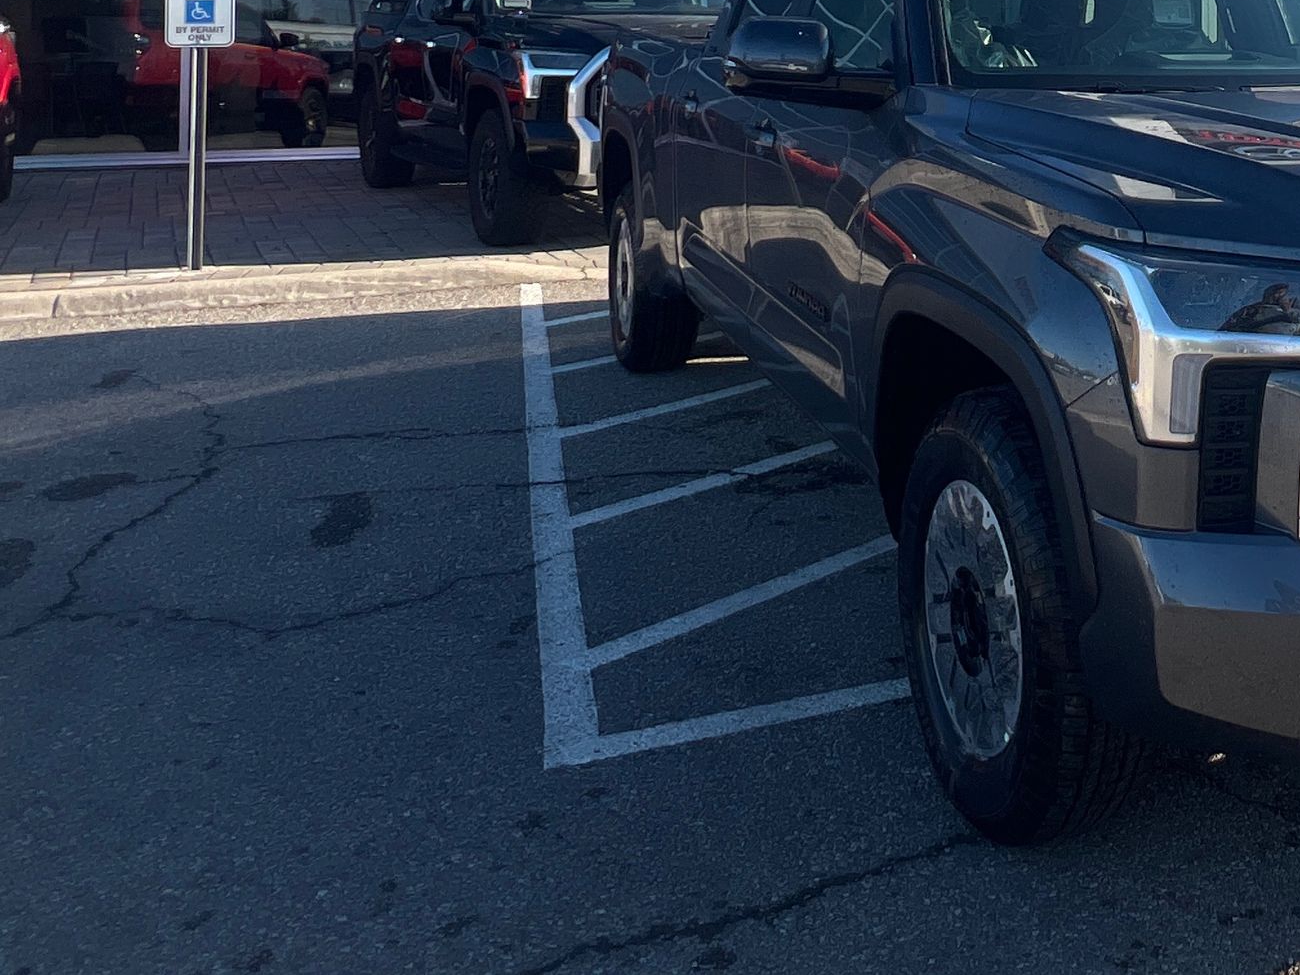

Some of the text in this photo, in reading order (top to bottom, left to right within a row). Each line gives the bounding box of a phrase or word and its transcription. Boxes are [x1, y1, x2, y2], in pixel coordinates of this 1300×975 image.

[175, 26, 225, 34] BY PERMIT
[187, 33, 213, 42] ONLY
